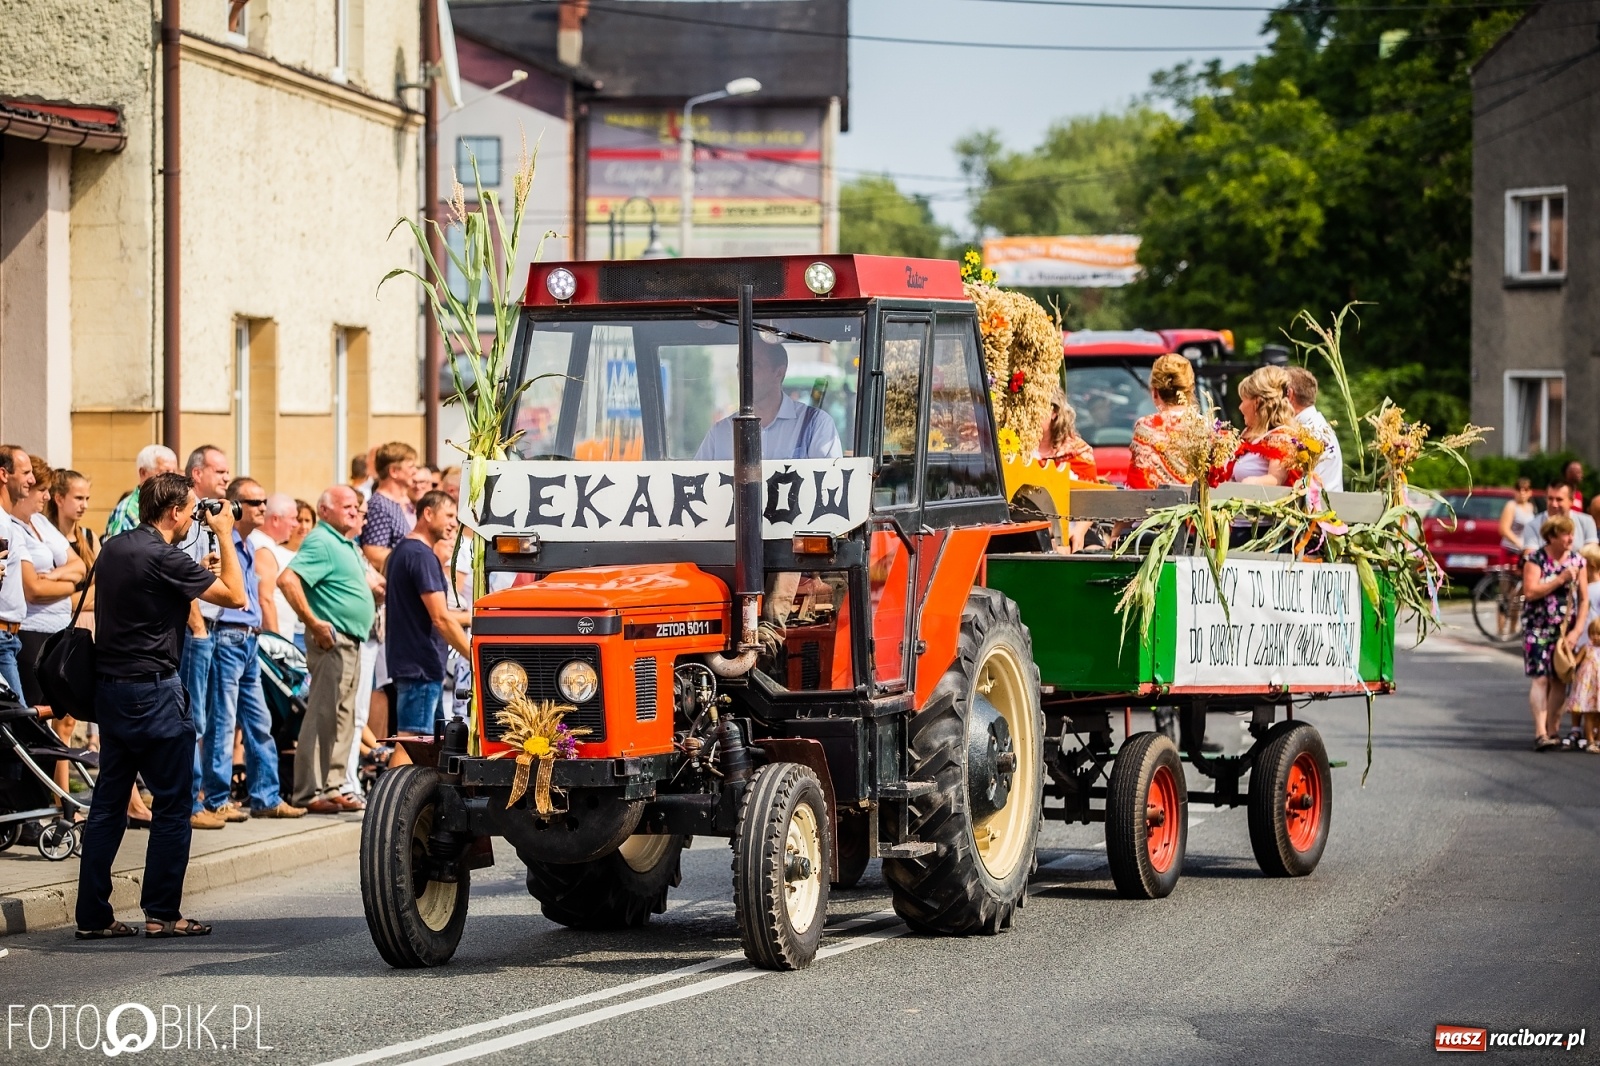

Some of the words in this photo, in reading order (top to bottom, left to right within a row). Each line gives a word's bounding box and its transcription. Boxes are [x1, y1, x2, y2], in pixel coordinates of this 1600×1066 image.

[1248, 570, 1265, 608] TO
[1271, 569, 1304, 613] LUDZIE
[1311, 570, 1351, 616] MOROWI
[656, 623, 686, 637] ZETOR
[687, 621, 710, 635] 5011
[1189, 627, 1203, 664] DO
[1209, 623, 1243, 667] ROBOTY
[1245, 623, 1255, 667] I
[1253, 623, 1295, 667] ZABAWY
[1293, 623, 1324, 667] ZAWSZE
